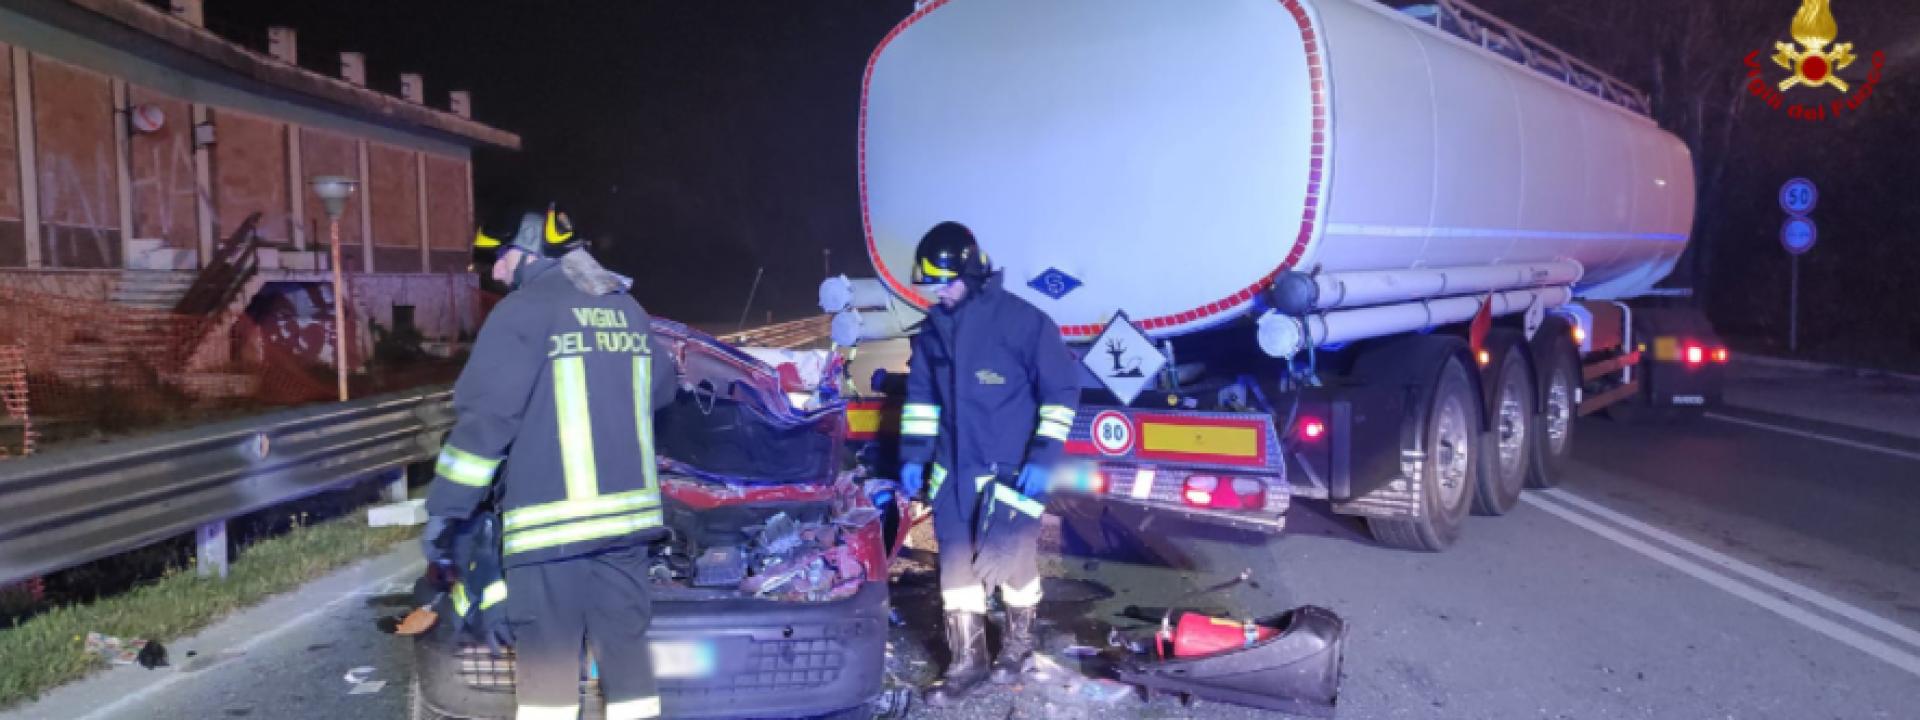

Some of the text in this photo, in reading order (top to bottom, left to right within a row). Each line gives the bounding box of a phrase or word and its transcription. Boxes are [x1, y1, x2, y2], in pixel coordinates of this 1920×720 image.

[1789, 188, 1809, 206] 50
[571, 307, 628, 328] VIGILI
[547, 332, 592, 357] DEL
[1103, 422, 1123, 441] 80
